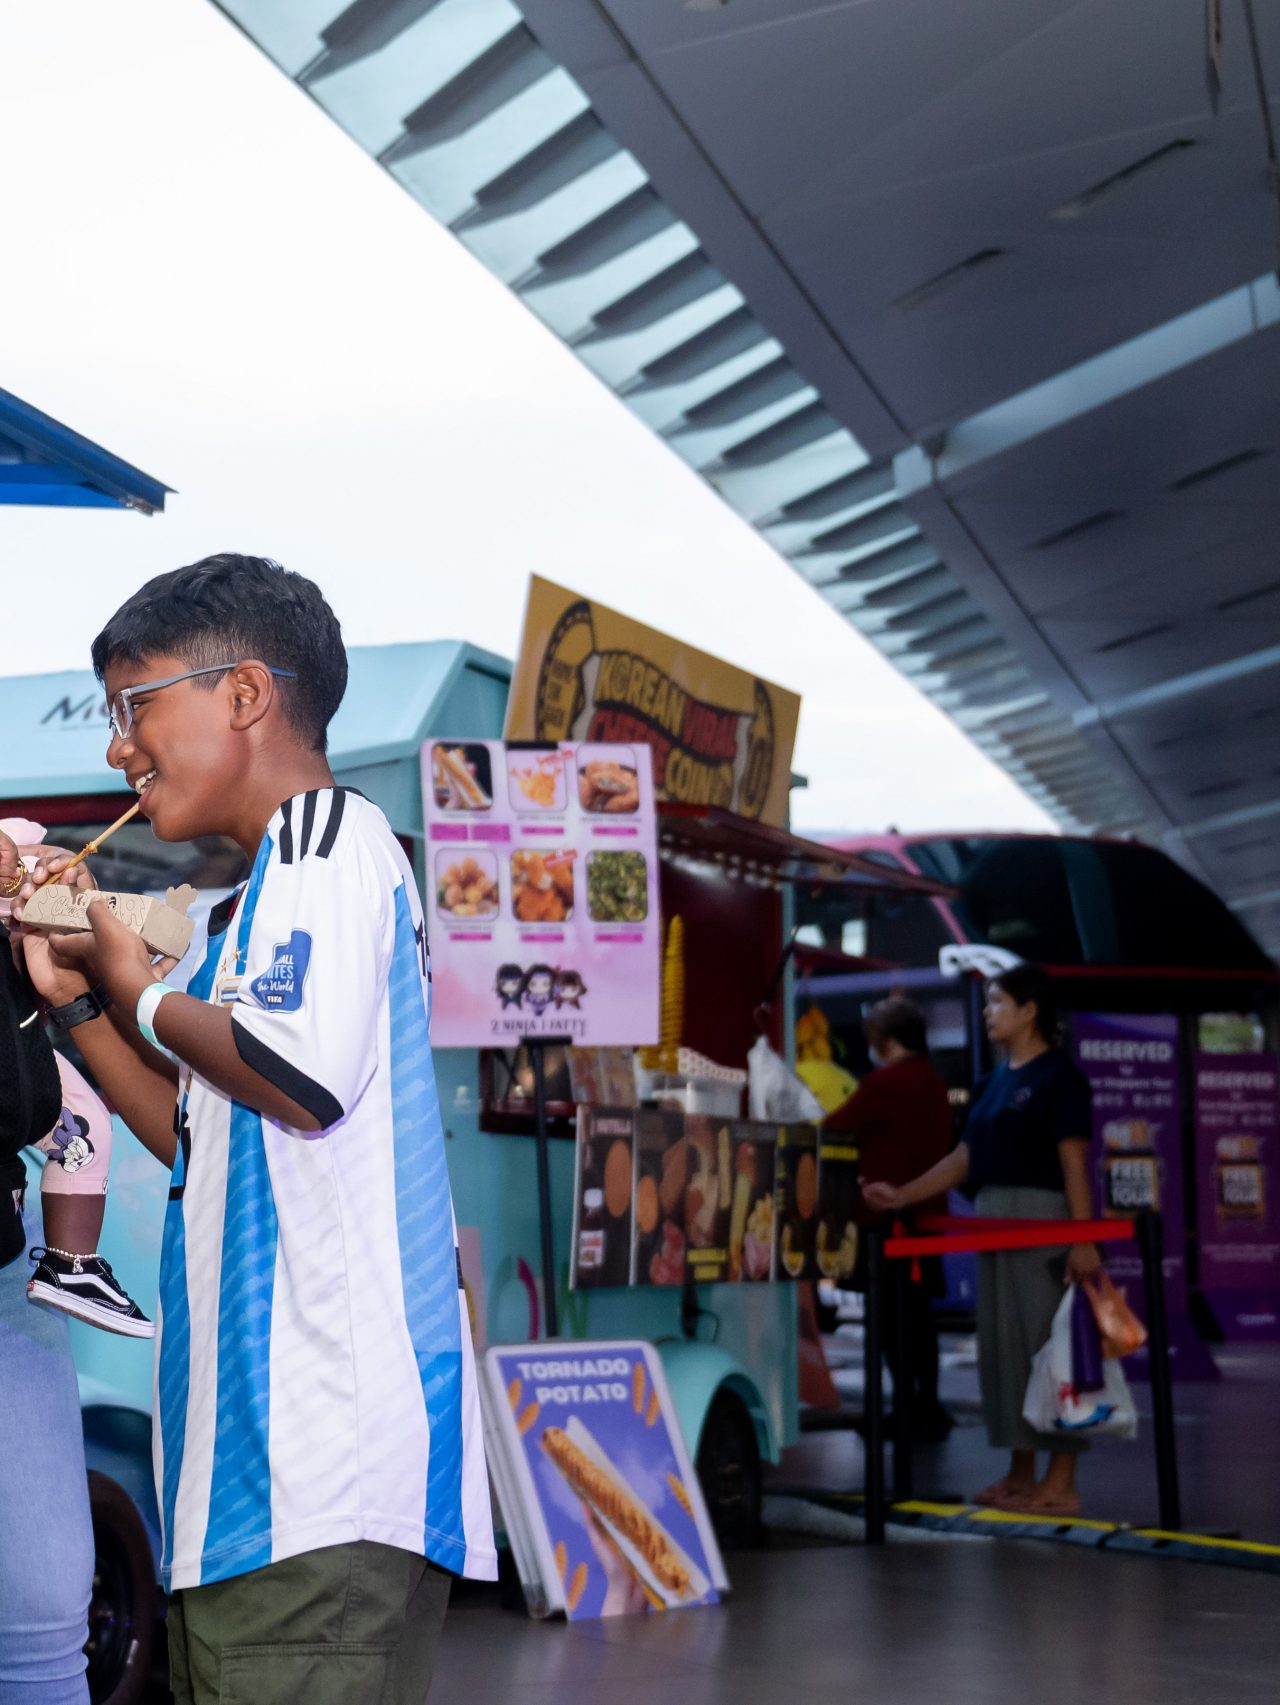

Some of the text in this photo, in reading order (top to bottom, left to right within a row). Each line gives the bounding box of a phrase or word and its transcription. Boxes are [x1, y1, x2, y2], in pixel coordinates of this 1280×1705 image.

[597, 652, 688, 738] KOREAN
[270, 980, 295, 992] World
[267, 995, 282, 1003] FIFA
[1079, 1040, 1171, 1061] RESERVED
[517, 1358, 630, 1380] TORNADO
[535, 1382, 628, 1406] POTATO
